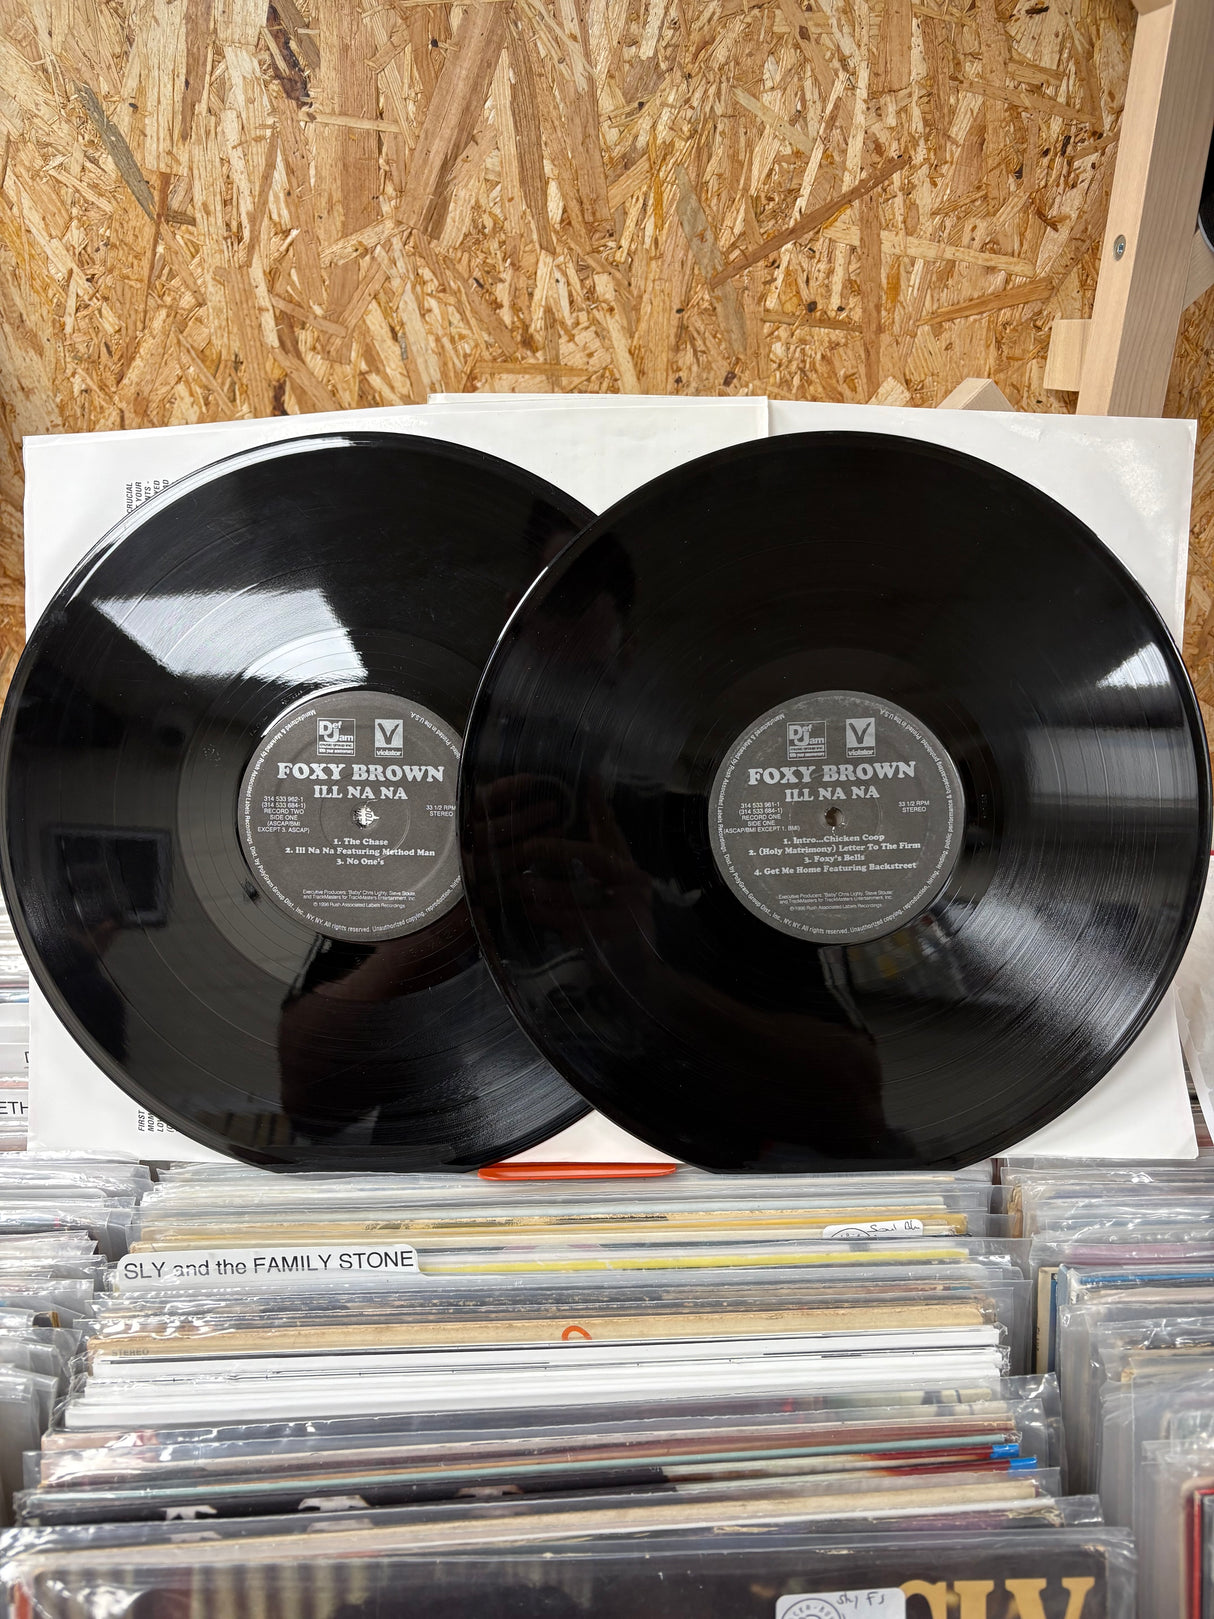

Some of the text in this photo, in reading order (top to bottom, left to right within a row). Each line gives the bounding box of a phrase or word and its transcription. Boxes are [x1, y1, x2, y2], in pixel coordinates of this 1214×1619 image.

[277, 763, 444, 782] FOXY BROWN
[748, 761, 916, 785] FOXY BROWN
[313, 785, 408, 800] ILL NA NA
[785, 785, 880, 801] ILL NA NA
[337, 847, 380, 856] Featuring
[759, 848, 783, 856] (Holy
[785, 845, 836, 854] Matrimony)
[839, 844, 865, 852] Letter
[814, 855, 842, 863] Foxy's
[796, 865, 821, 873] Home
[823, 864, 867, 872] Featuring
[869, 862, 917, 870] Backstreet
[256, 864, 275, 888] PolyGram
[731, 871, 750, 896] PolyGram
[800, 923, 809, 931] All
[808, 926, 824, 934] rights
[124, 1250, 414, 1279] SLY and the FAMILY STONE
